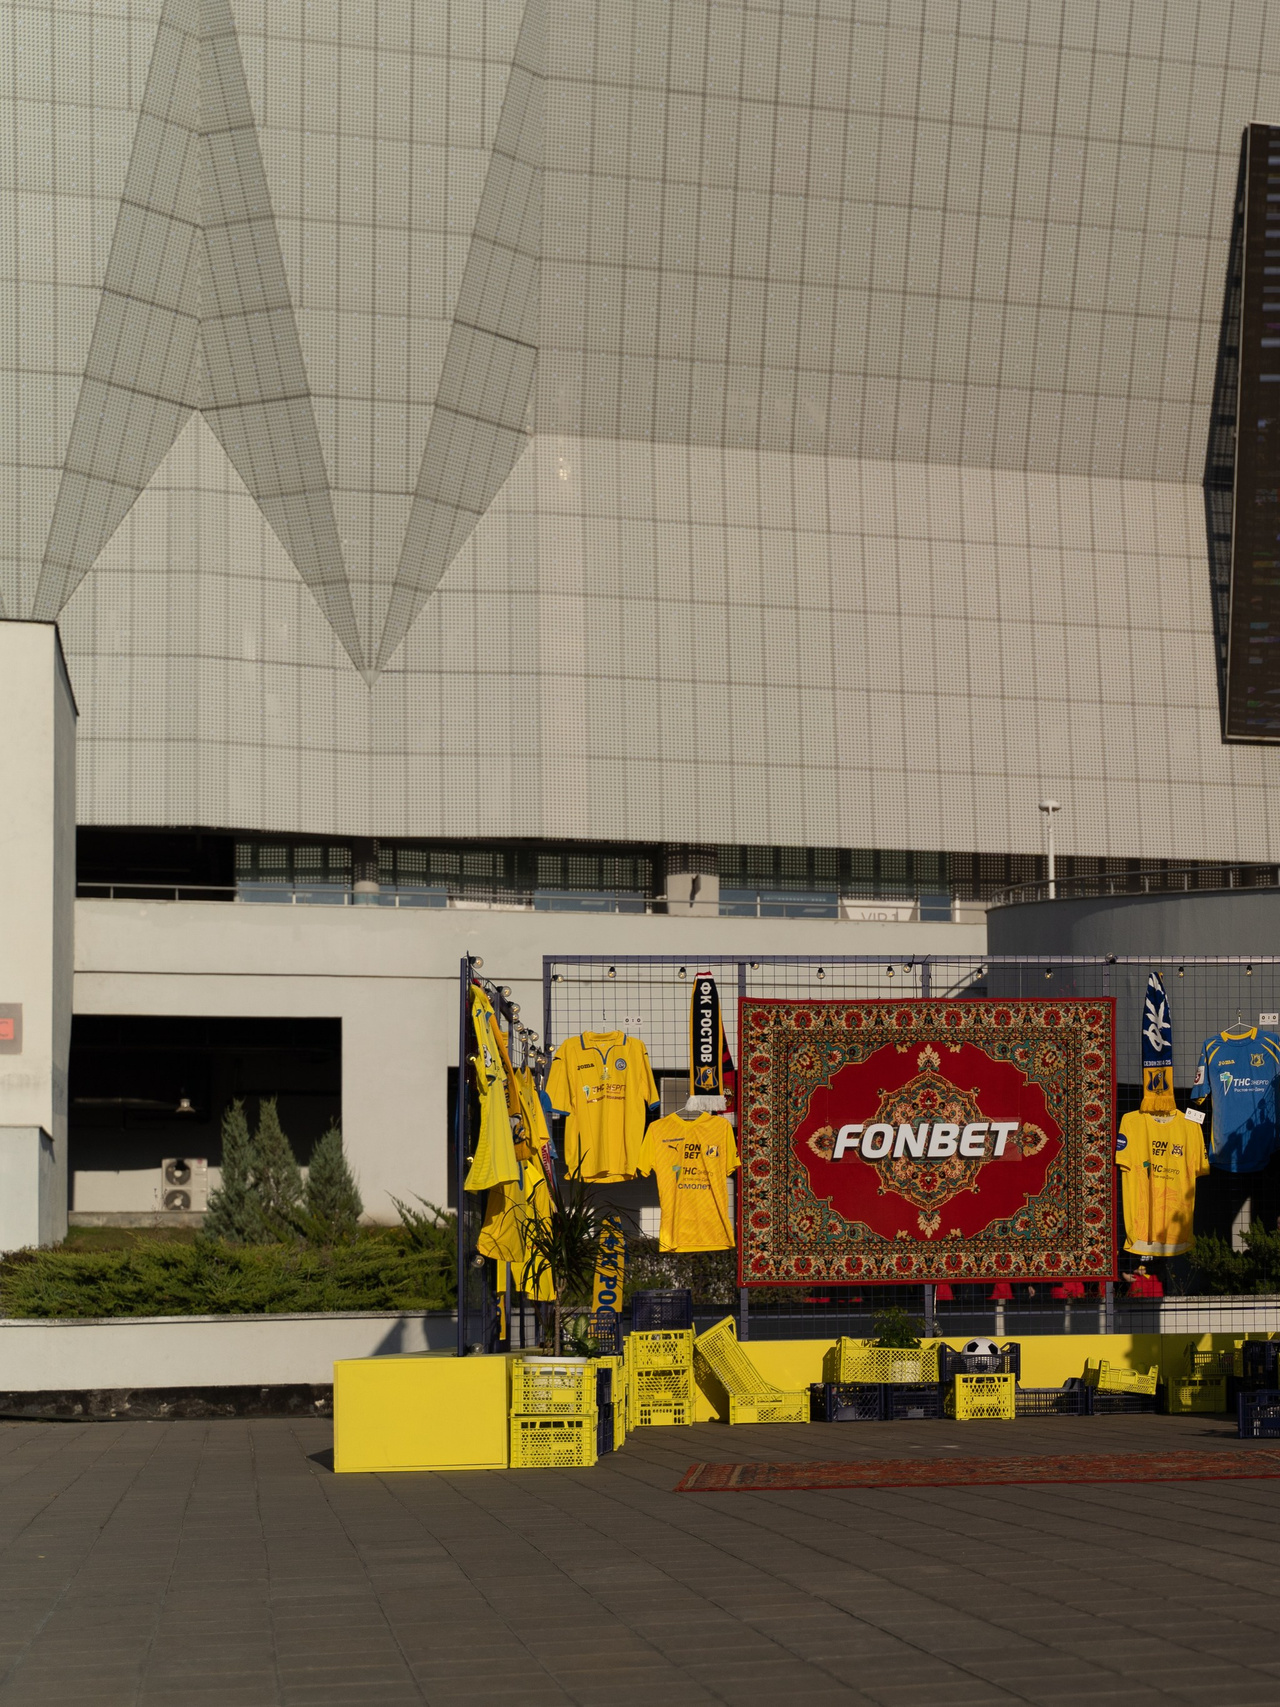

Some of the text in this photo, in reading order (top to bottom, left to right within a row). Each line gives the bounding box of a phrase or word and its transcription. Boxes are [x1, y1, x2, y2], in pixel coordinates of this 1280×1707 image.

[700, 981, 713, 1063] ФК РОСТОВ
[1233, 1078, 1251, 1087] ТНС
[833, 1121, 1019, 1159] FONBET
[684, 1143, 702, 1152] FON
[684, 1151, 701, 1160] BET
